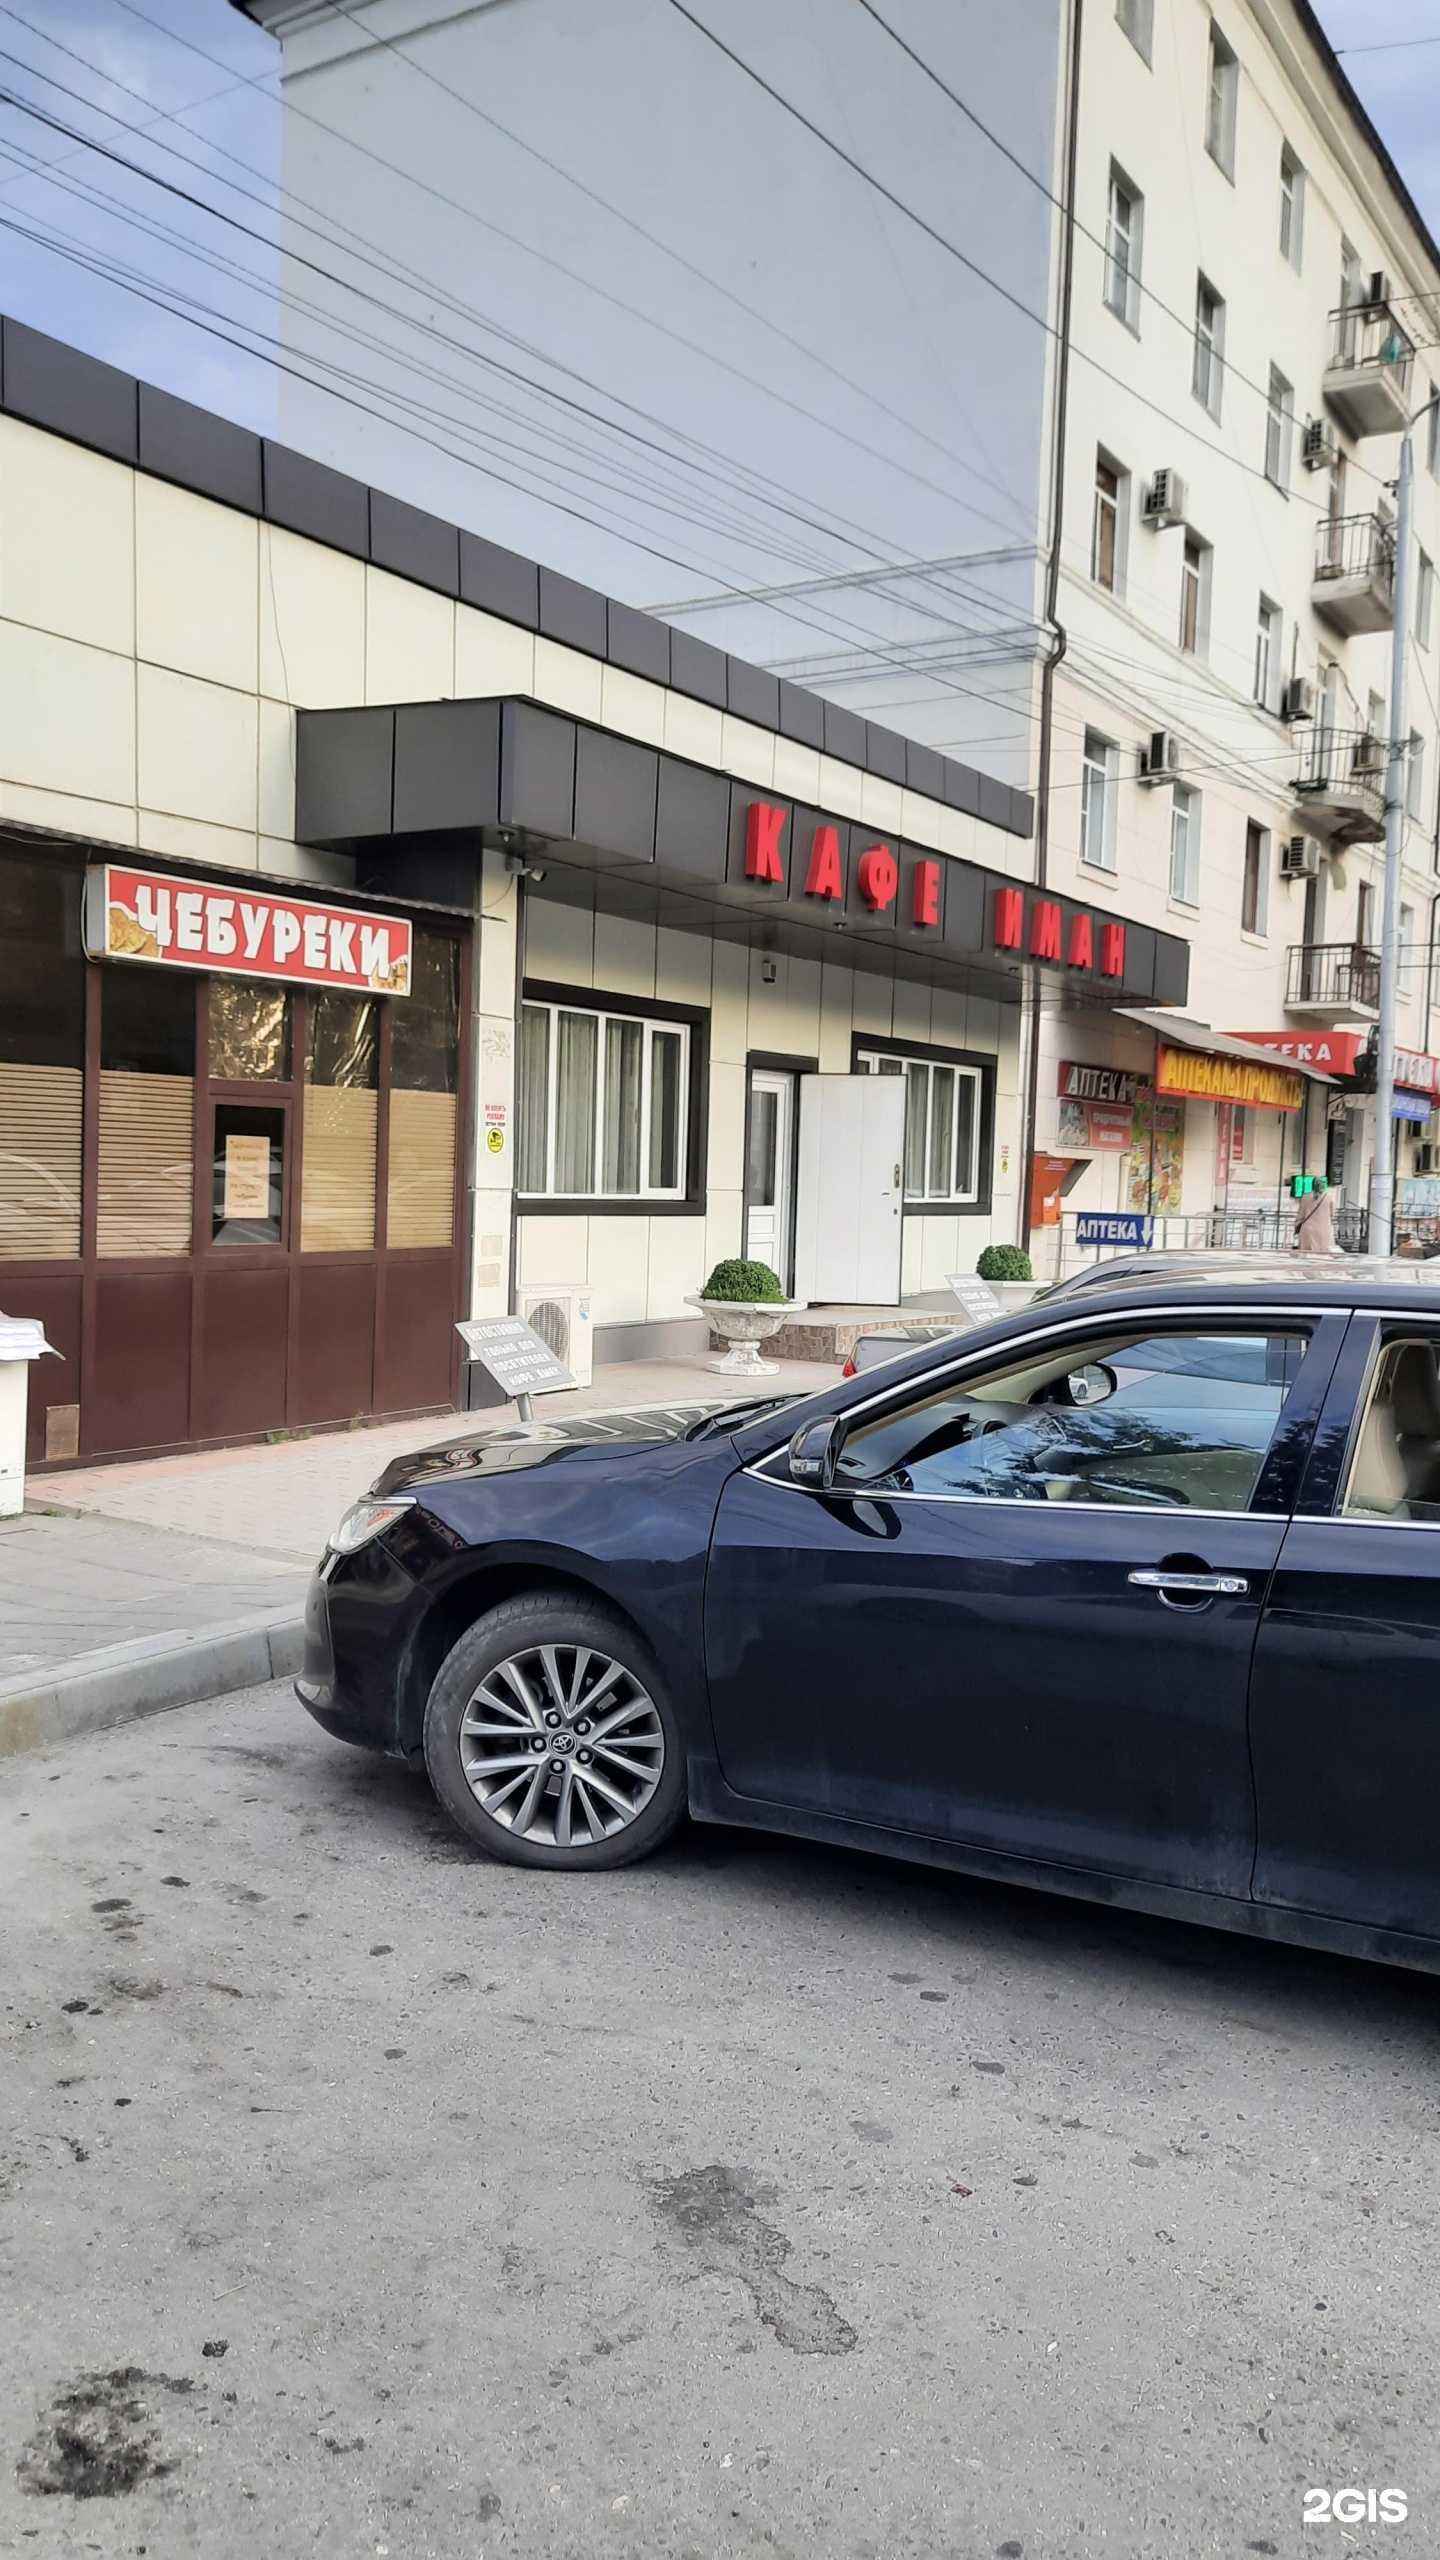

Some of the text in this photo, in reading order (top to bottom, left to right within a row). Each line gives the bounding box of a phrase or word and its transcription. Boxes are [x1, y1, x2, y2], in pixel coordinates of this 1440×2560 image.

[744, 802, 1126, 977] КАФЕ ИМАН
[135, 885, 390, 978] ЧЕБУРЕКИ
[1067, 1066, 1127, 1101] АПТЕКА
[1076, 1219, 1138, 1240] АПТЕКА
